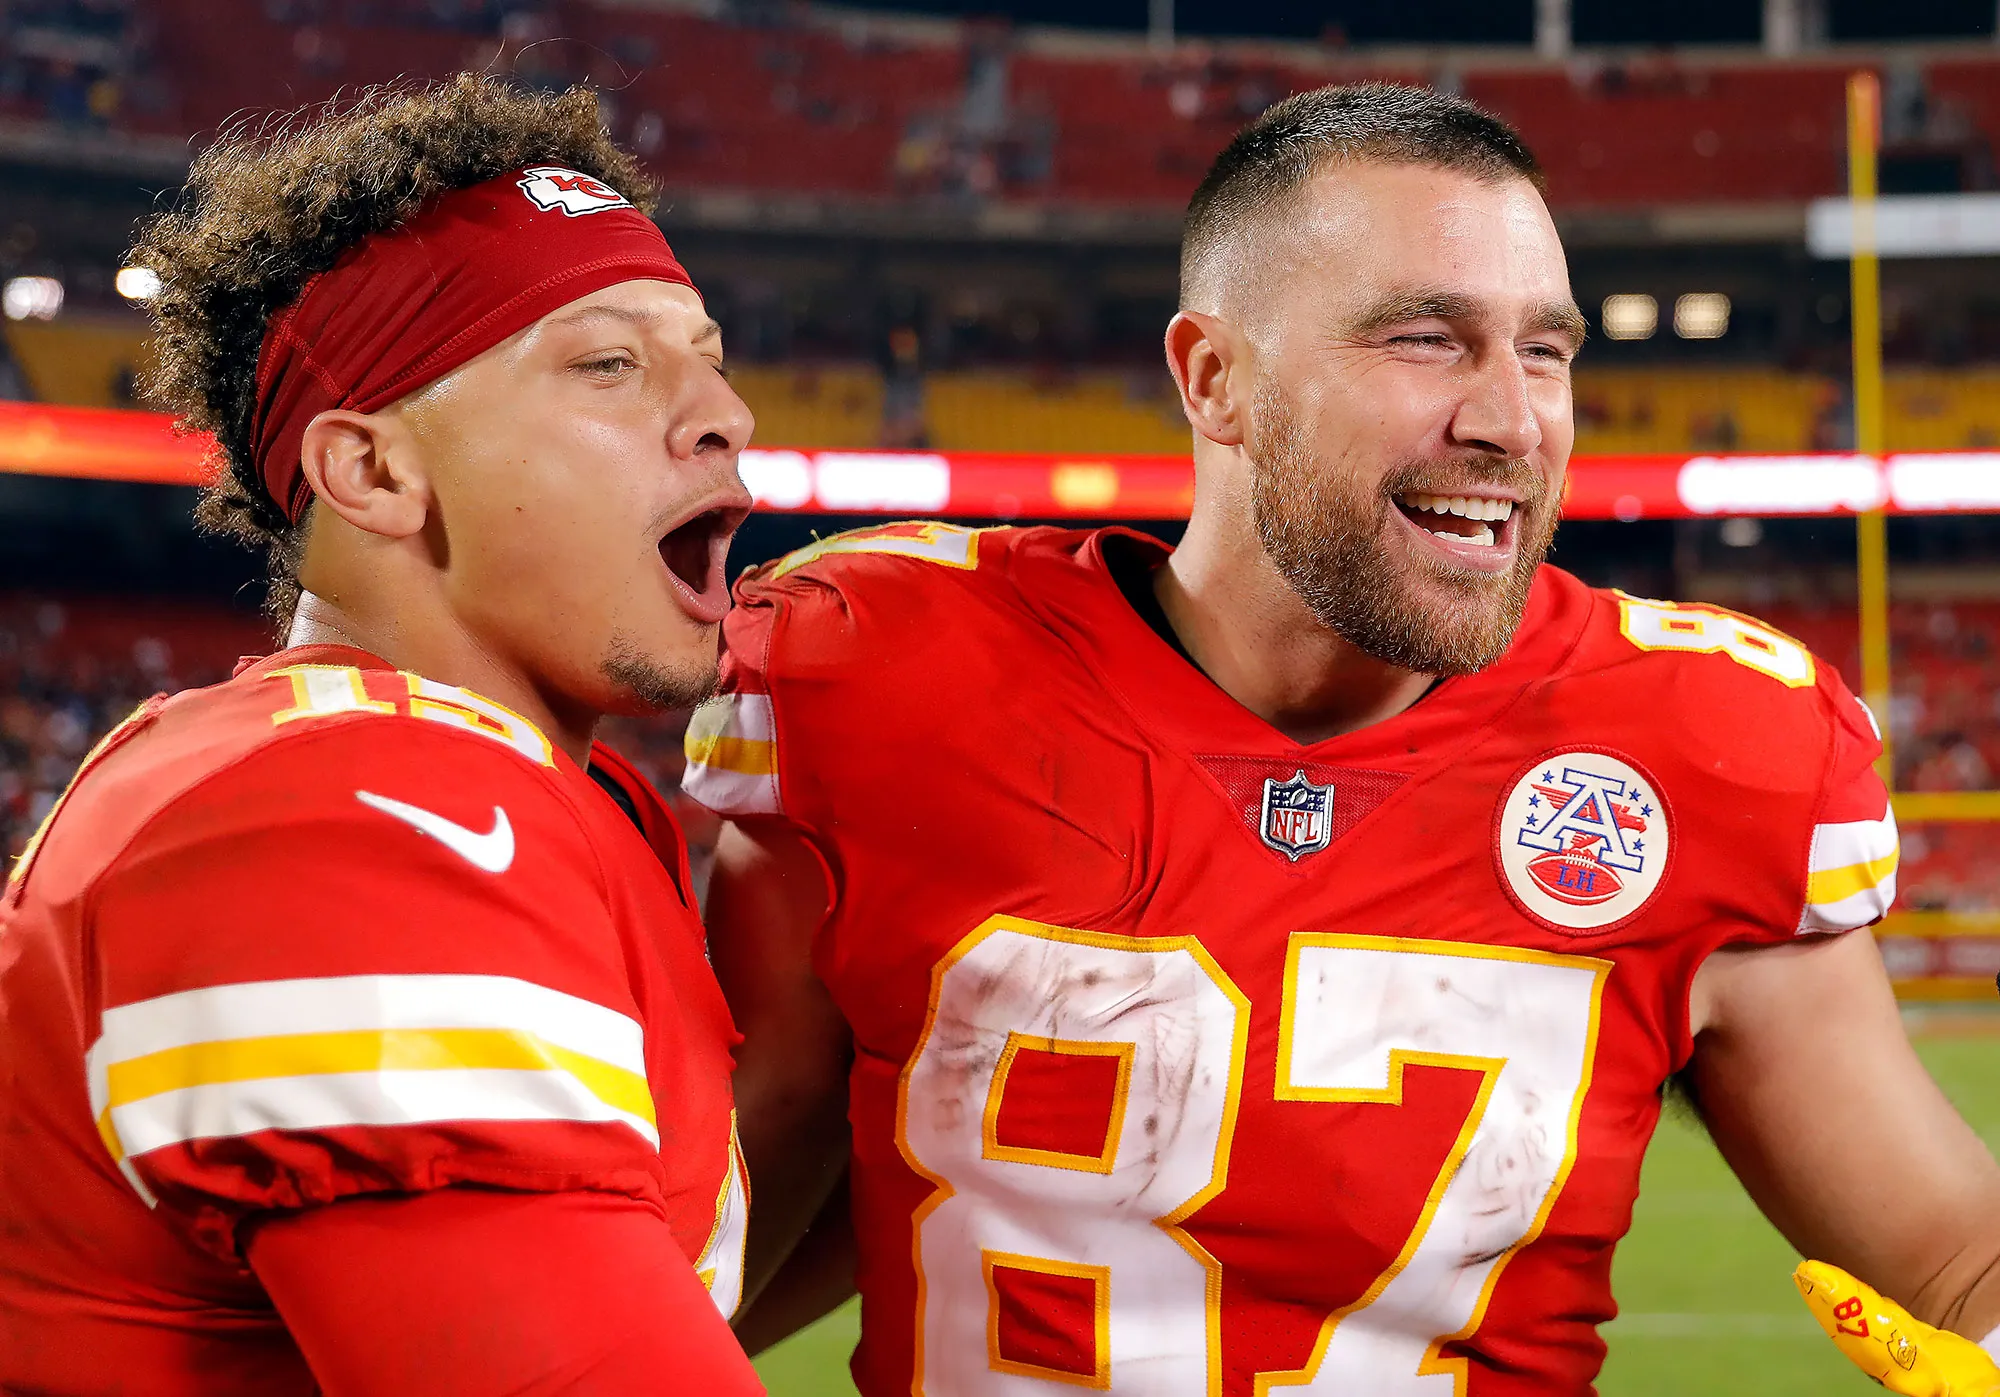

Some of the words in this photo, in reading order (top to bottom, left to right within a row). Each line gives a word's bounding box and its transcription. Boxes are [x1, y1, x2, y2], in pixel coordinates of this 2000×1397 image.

[264, 663, 559, 771] 15
[1271, 809, 1318, 845] NFL
[1517, 768, 1644, 873] A
[1556, 865, 1597, 893] LH
[894, 913, 1615, 1397] 87
[1833, 1295, 1870, 1338] 87
